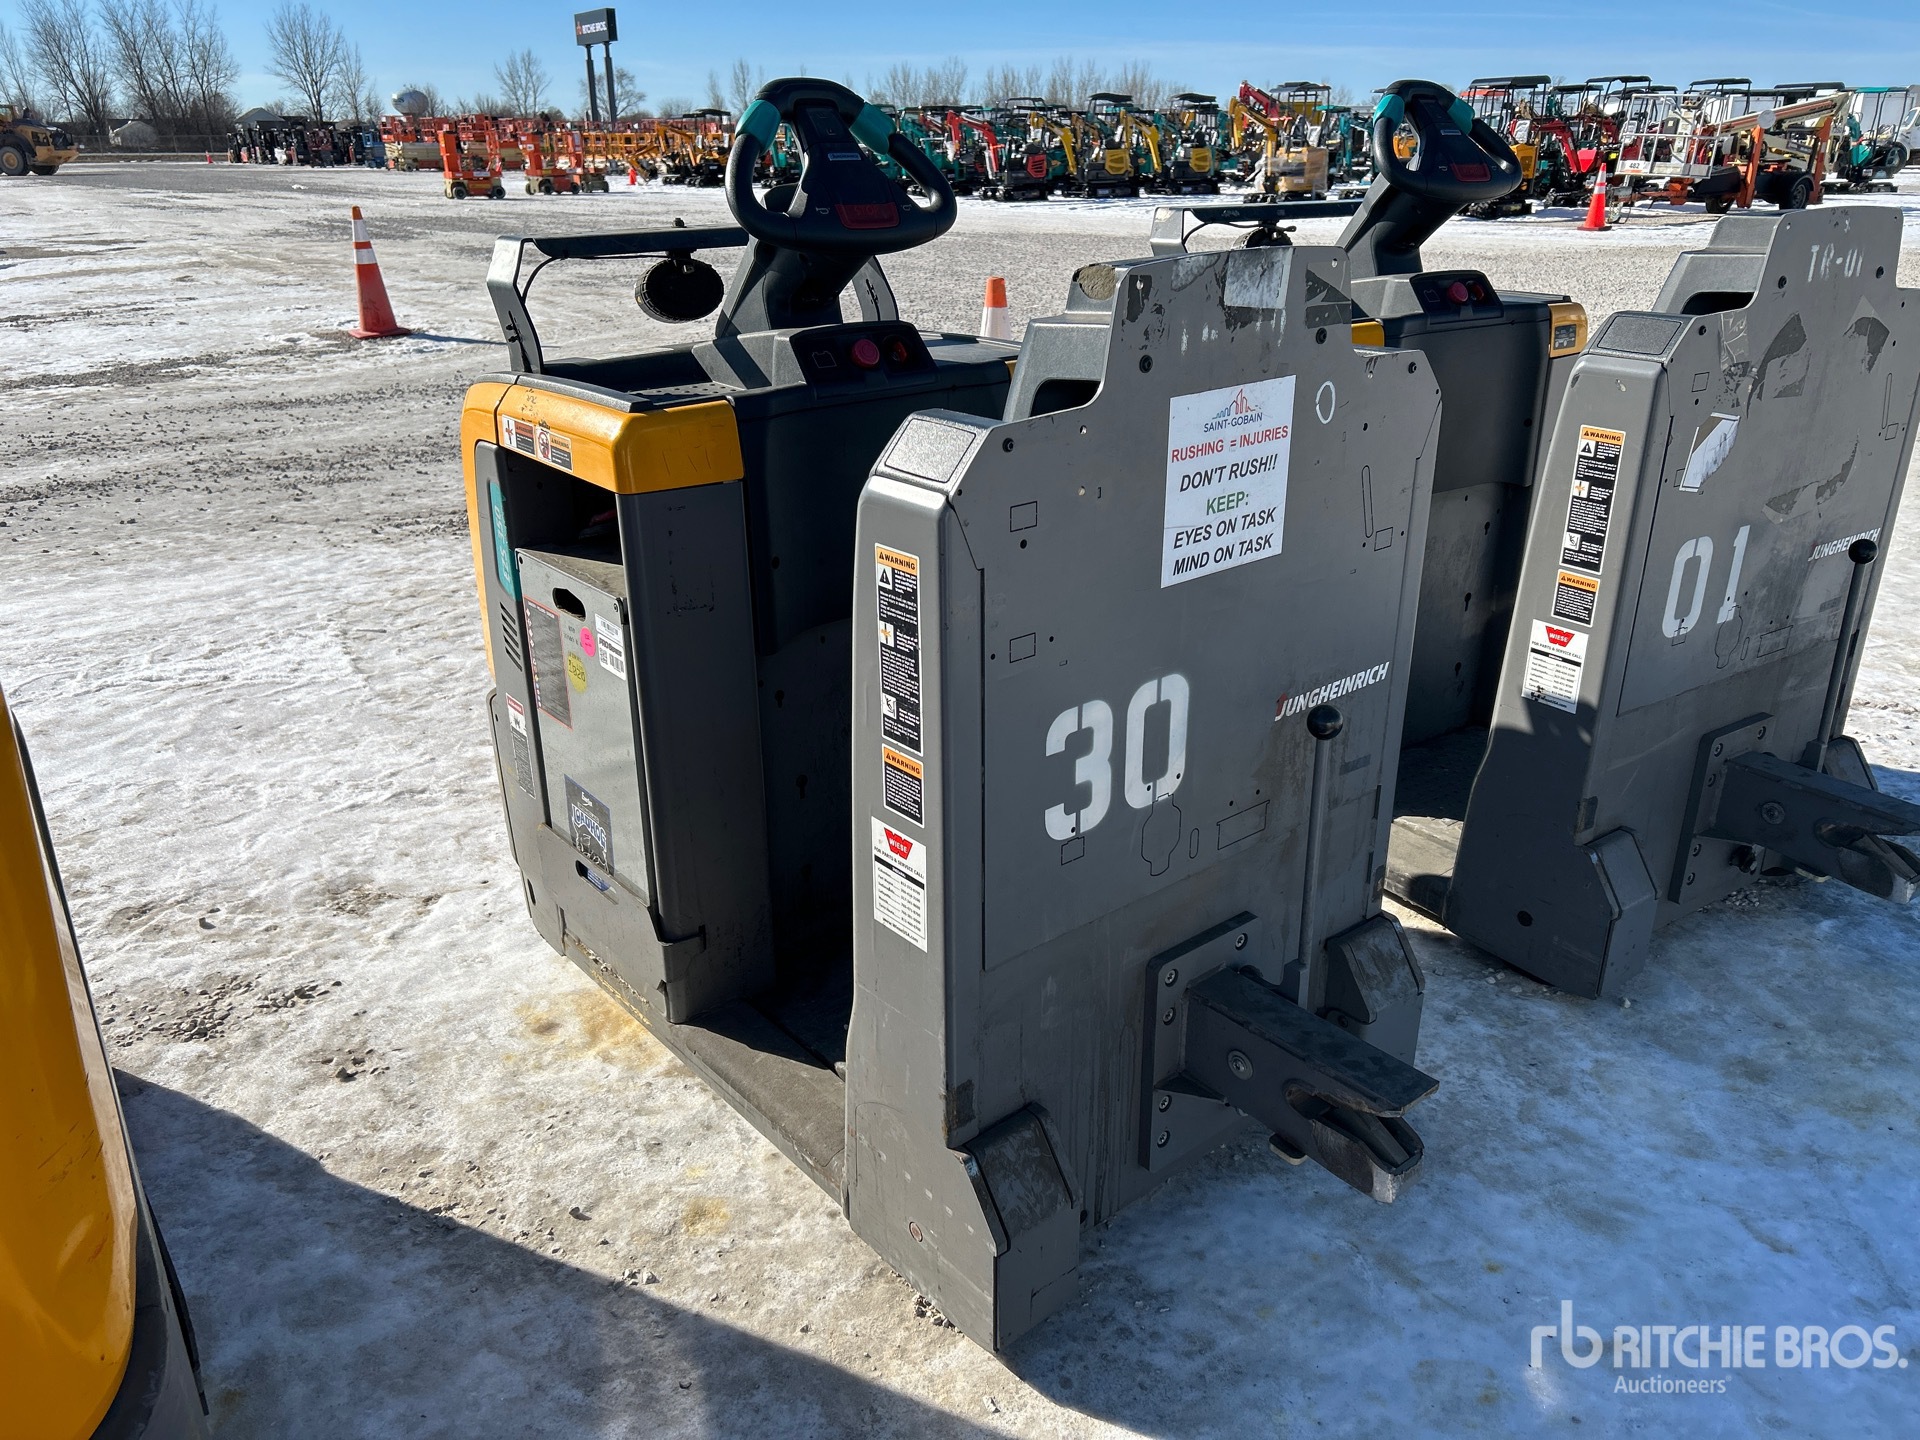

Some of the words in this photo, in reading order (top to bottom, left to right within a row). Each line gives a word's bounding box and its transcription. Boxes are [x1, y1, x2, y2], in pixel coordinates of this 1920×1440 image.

[1203, 412, 1263, 433] SAINT-GOBAIN
[1171, 438, 1224, 463] RUSHING
[1239, 425, 1289, 448] INJURIES
[1589, 432, 1621, 442] WARNING
[1180, 465, 1226, 493] DON'T
[1228, 453, 1278, 482] RUSH!!
[1206, 490, 1249, 516] KEEP:
[1173, 524, 1212, 550] EYES
[1216, 517, 1238, 538] ON
[1241, 506, 1277, 531] TASK
[884, 553, 916, 571] WARNING
[1172, 551, 1209, 576] MIND
[1214, 543, 1234, 564] ON
[1238, 532, 1274, 557] TASK
[1566, 577, 1596, 589] WARNING
[1661, 524, 1751, 638] 01
[1549, 632, 1568, 643] WIESE
[1274, 661, 1390, 722] JUNGHEINRICH
[890, 756, 921, 775] WARNING
[1044, 673, 1190, 841] 30
[888, 838, 908, 854] WIESE
[881, 850, 893, 861] PARTS
[897, 859, 914, 873] SERVICE
